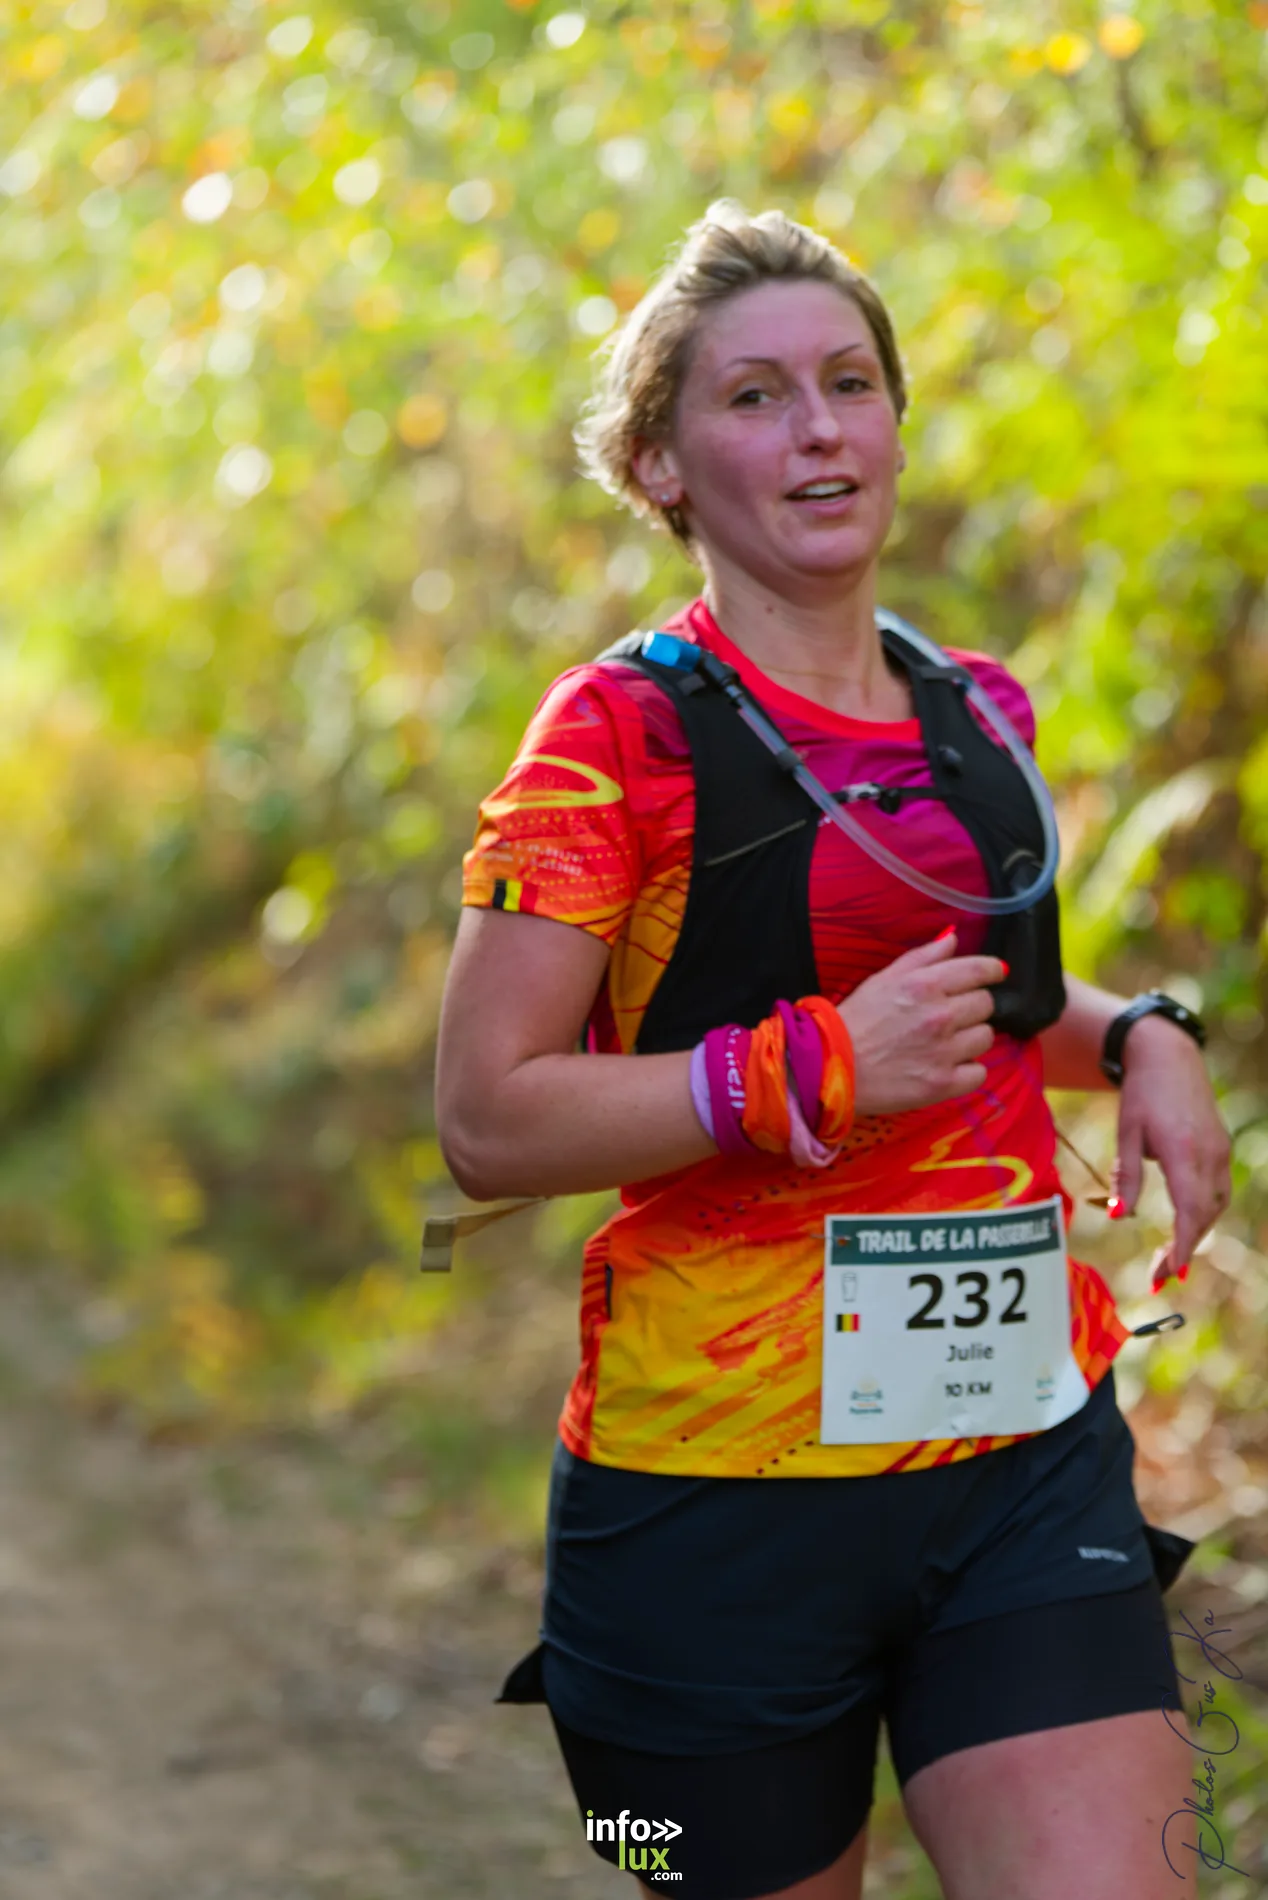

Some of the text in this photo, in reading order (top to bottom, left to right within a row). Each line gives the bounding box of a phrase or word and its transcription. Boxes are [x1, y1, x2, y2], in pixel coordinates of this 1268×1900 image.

[856, 1229, 917, 1253] TRAIL
[920, 1228, 947, 1251] DE
[950, 1226, 975, 1250] LA
[906, 1267, 1028, 1330] 232
[946, 1343, 994, 1362] Julie
[945, 1382, 992, 1398] 10 KM
